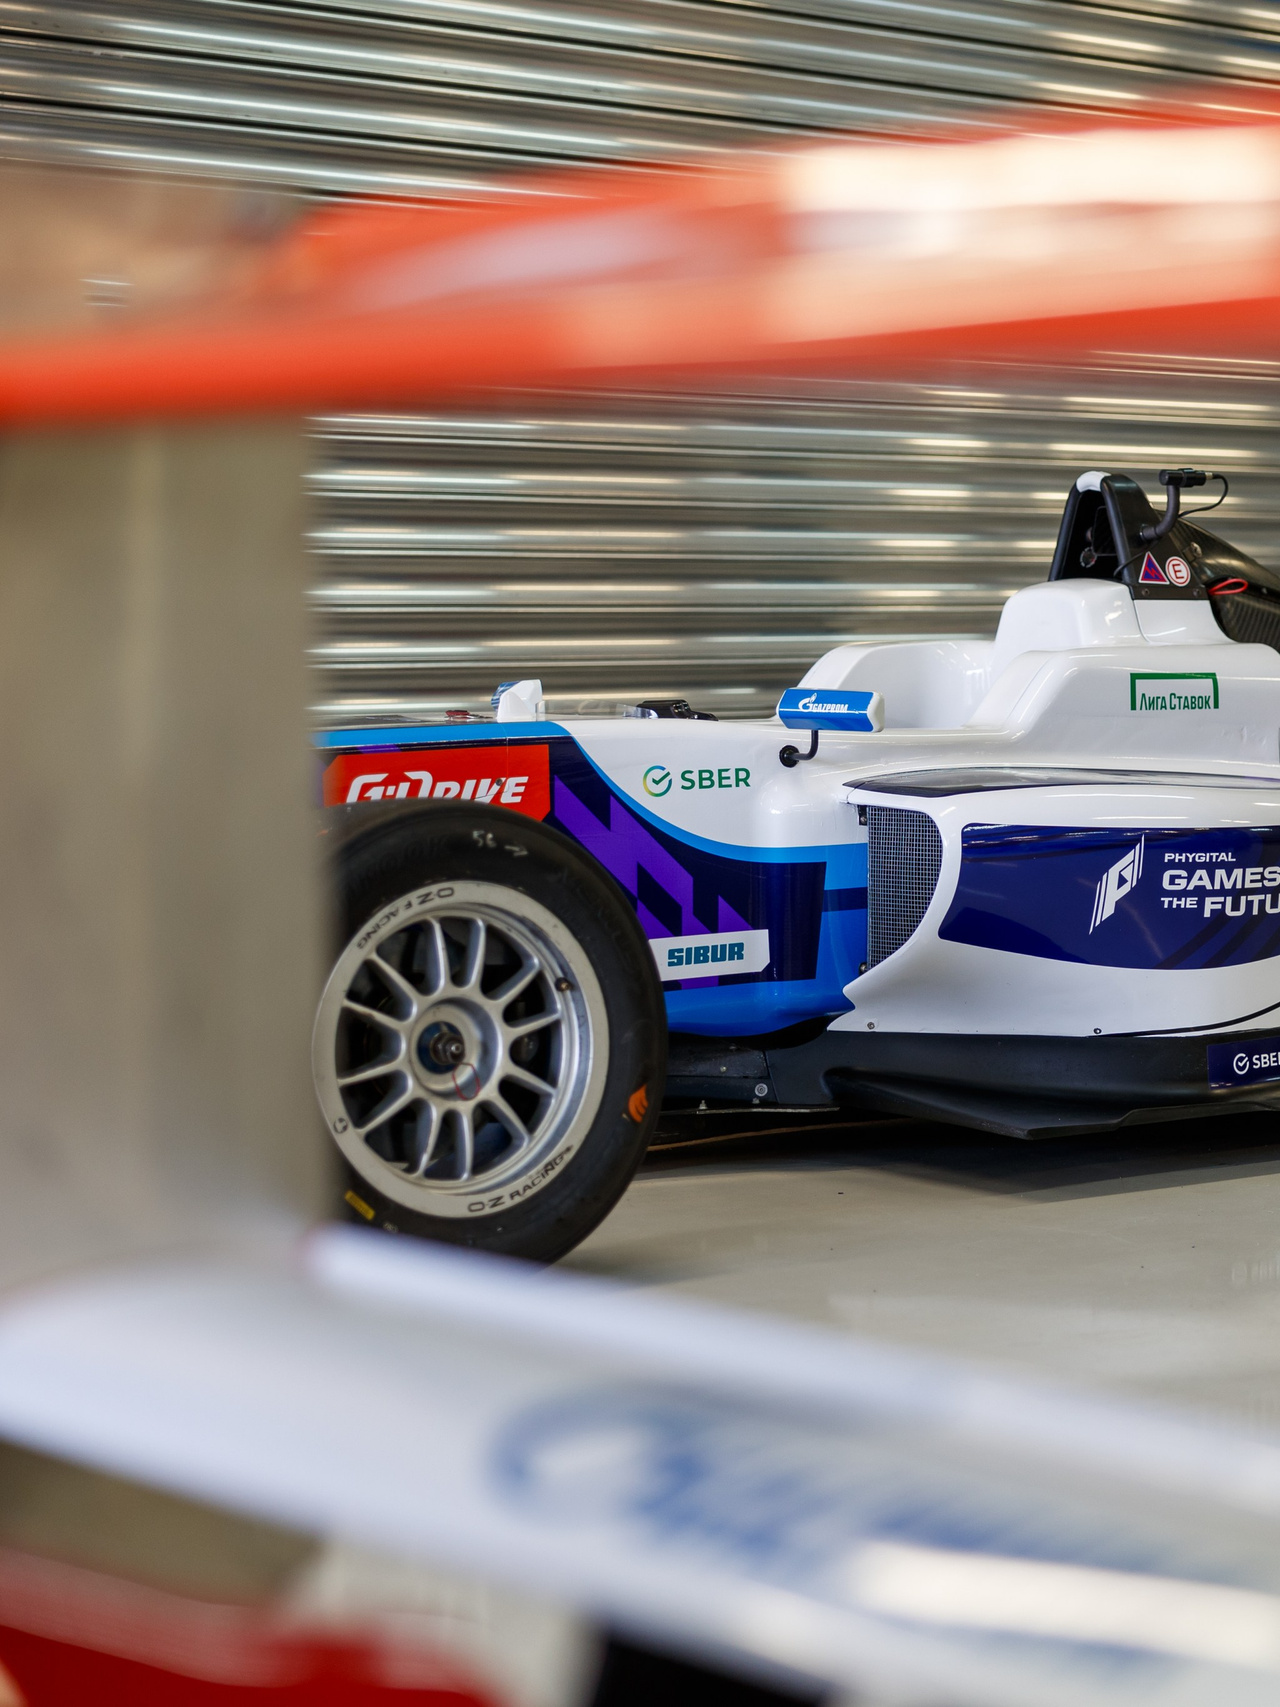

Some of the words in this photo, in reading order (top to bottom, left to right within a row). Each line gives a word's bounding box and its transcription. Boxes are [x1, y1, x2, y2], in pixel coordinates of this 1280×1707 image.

[680, 767, 751, 790] SBER
[1164, 852, 1236, 863] PHYGITAL
[1160, 897, 1198, 909] THE
[667, 942, 745, 968] SIBUR
